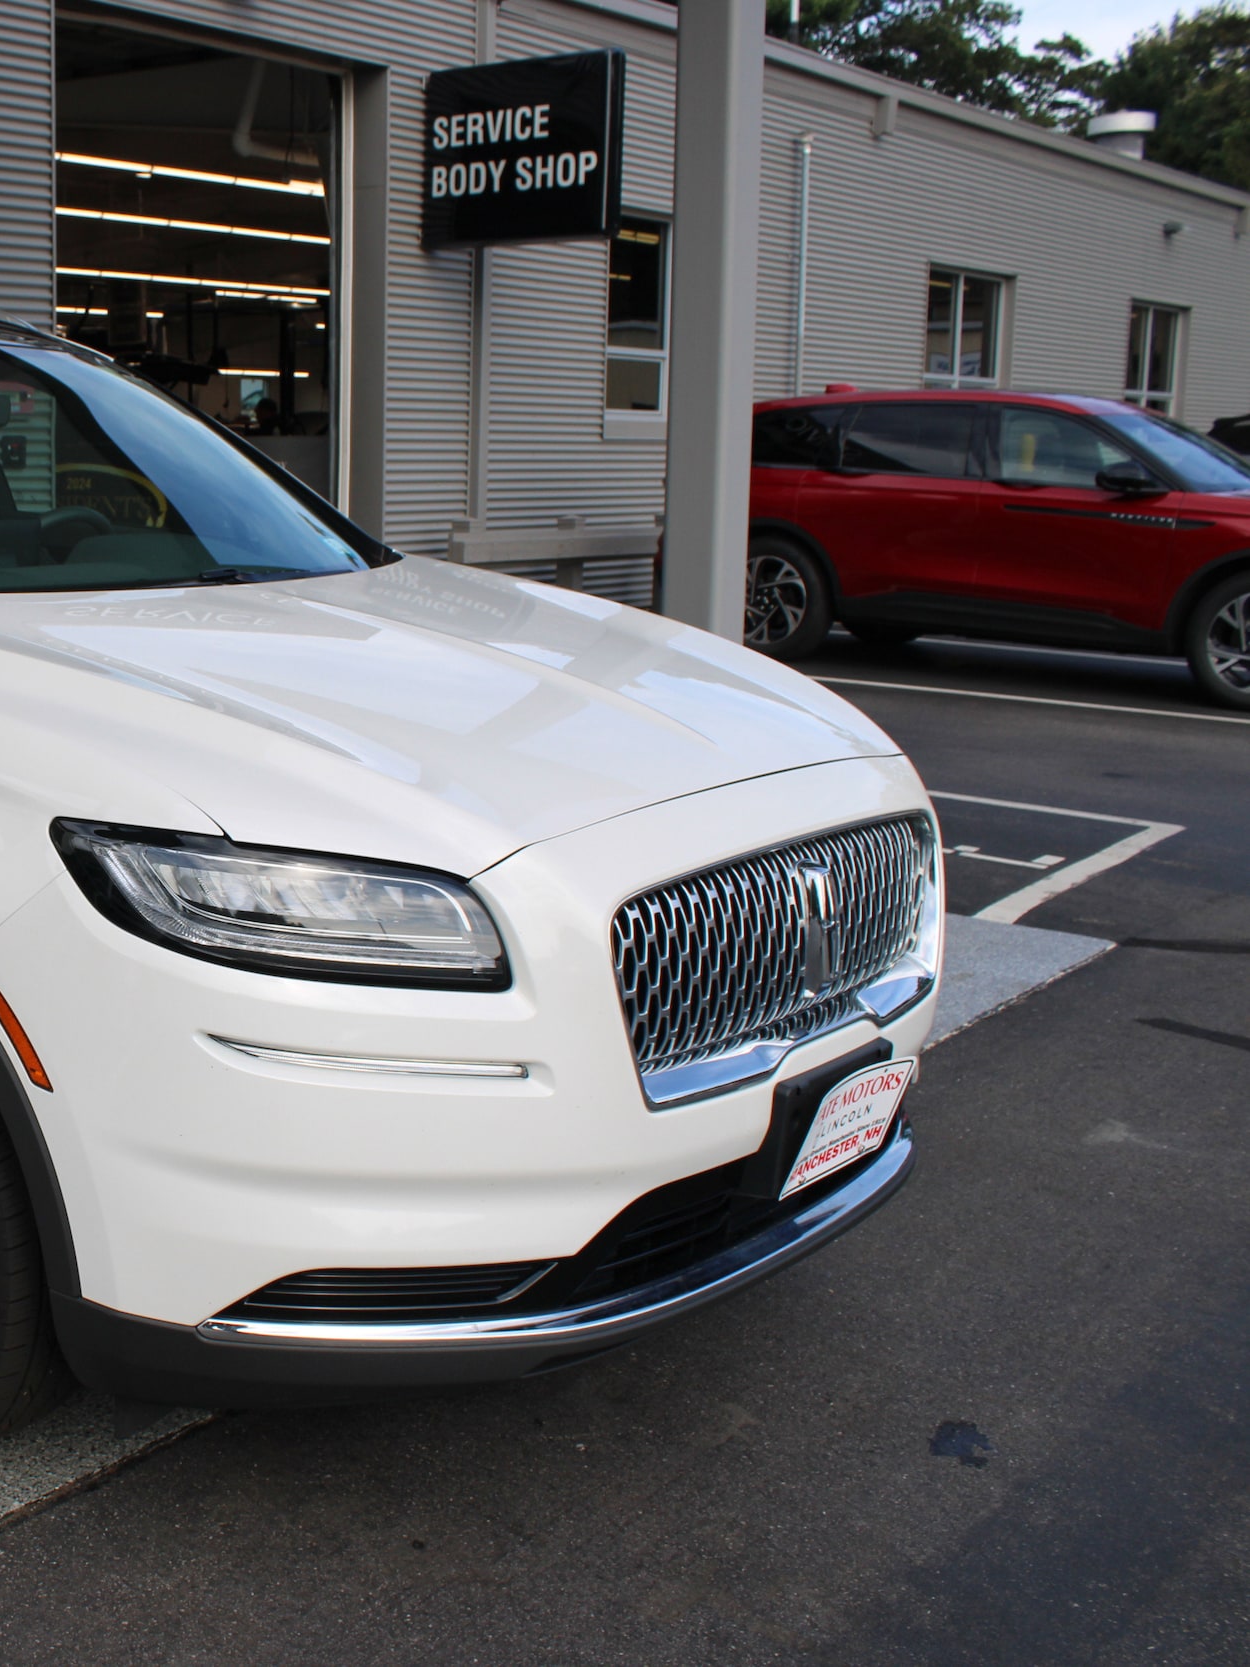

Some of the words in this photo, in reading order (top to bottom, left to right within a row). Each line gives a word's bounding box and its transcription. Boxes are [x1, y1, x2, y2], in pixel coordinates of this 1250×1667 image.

[432, 104, 551, 150] SERVICE
[431, 160, 507, 199] BODY
[514, 151, 598, 192] SHOP
[815, 1094, 841, 1126] ATE
[840, 1071, 904, 1108] MOTORS
[820, 1103, 872, 1138] LINCOLN
[863, 1125, 883, 1142] NH
